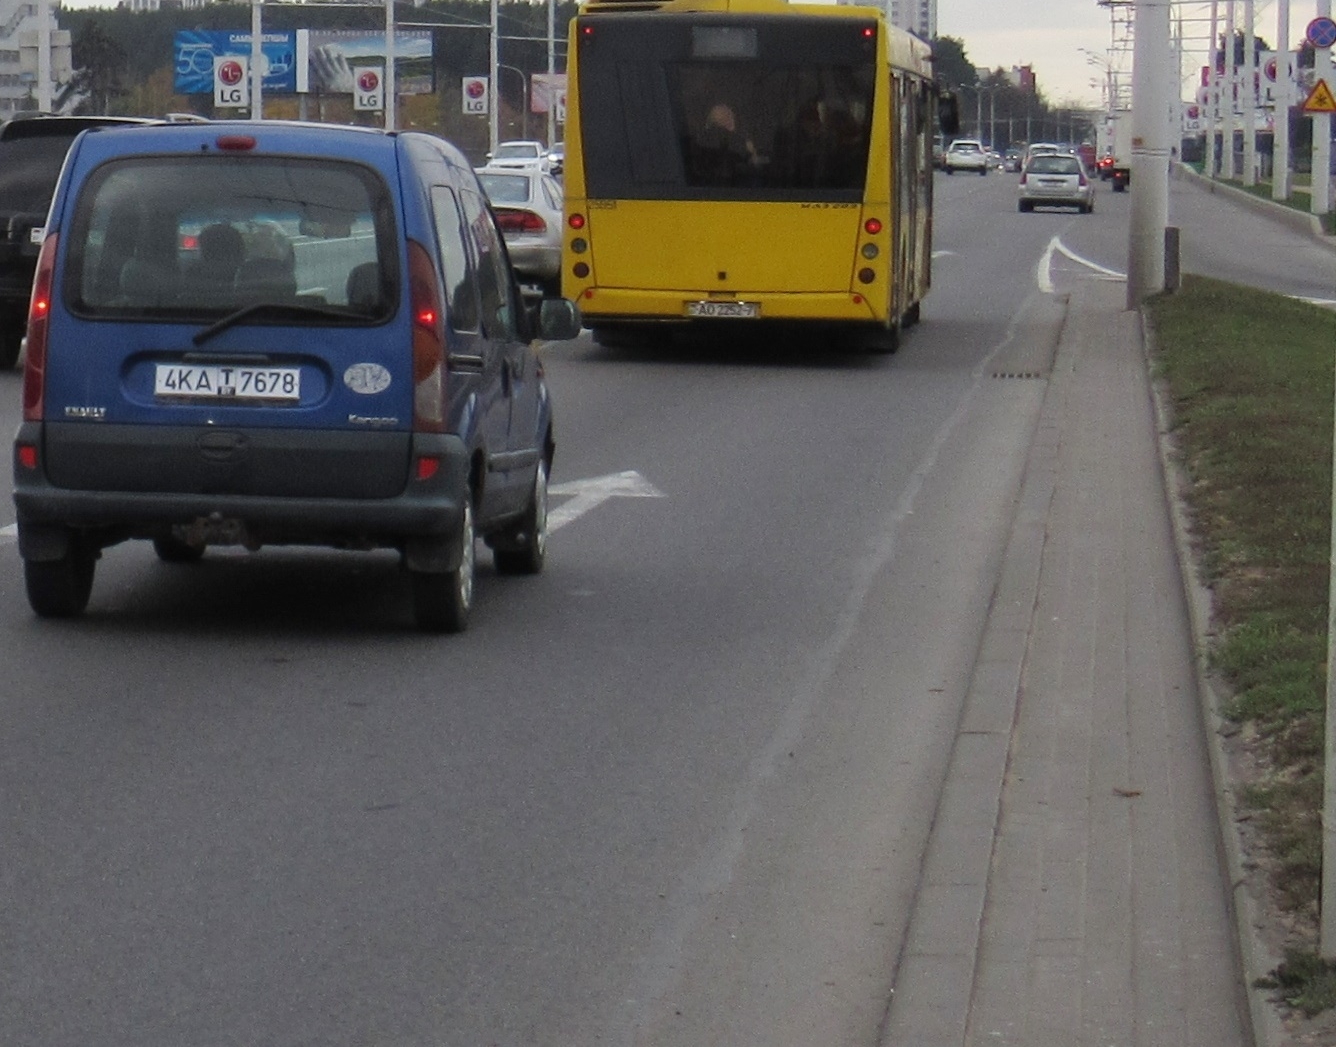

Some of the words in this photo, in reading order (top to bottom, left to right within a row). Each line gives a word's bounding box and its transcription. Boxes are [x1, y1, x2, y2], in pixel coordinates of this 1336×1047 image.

[220, 89, 241, 103] LG
[359, 95, 377, 107] LG
[466, 101, 483, 112] LG
[1186, 121, 1200, 130] LG
[164, 368, 212, 391] 4KA
[240, 370, 296, 394] 7678
